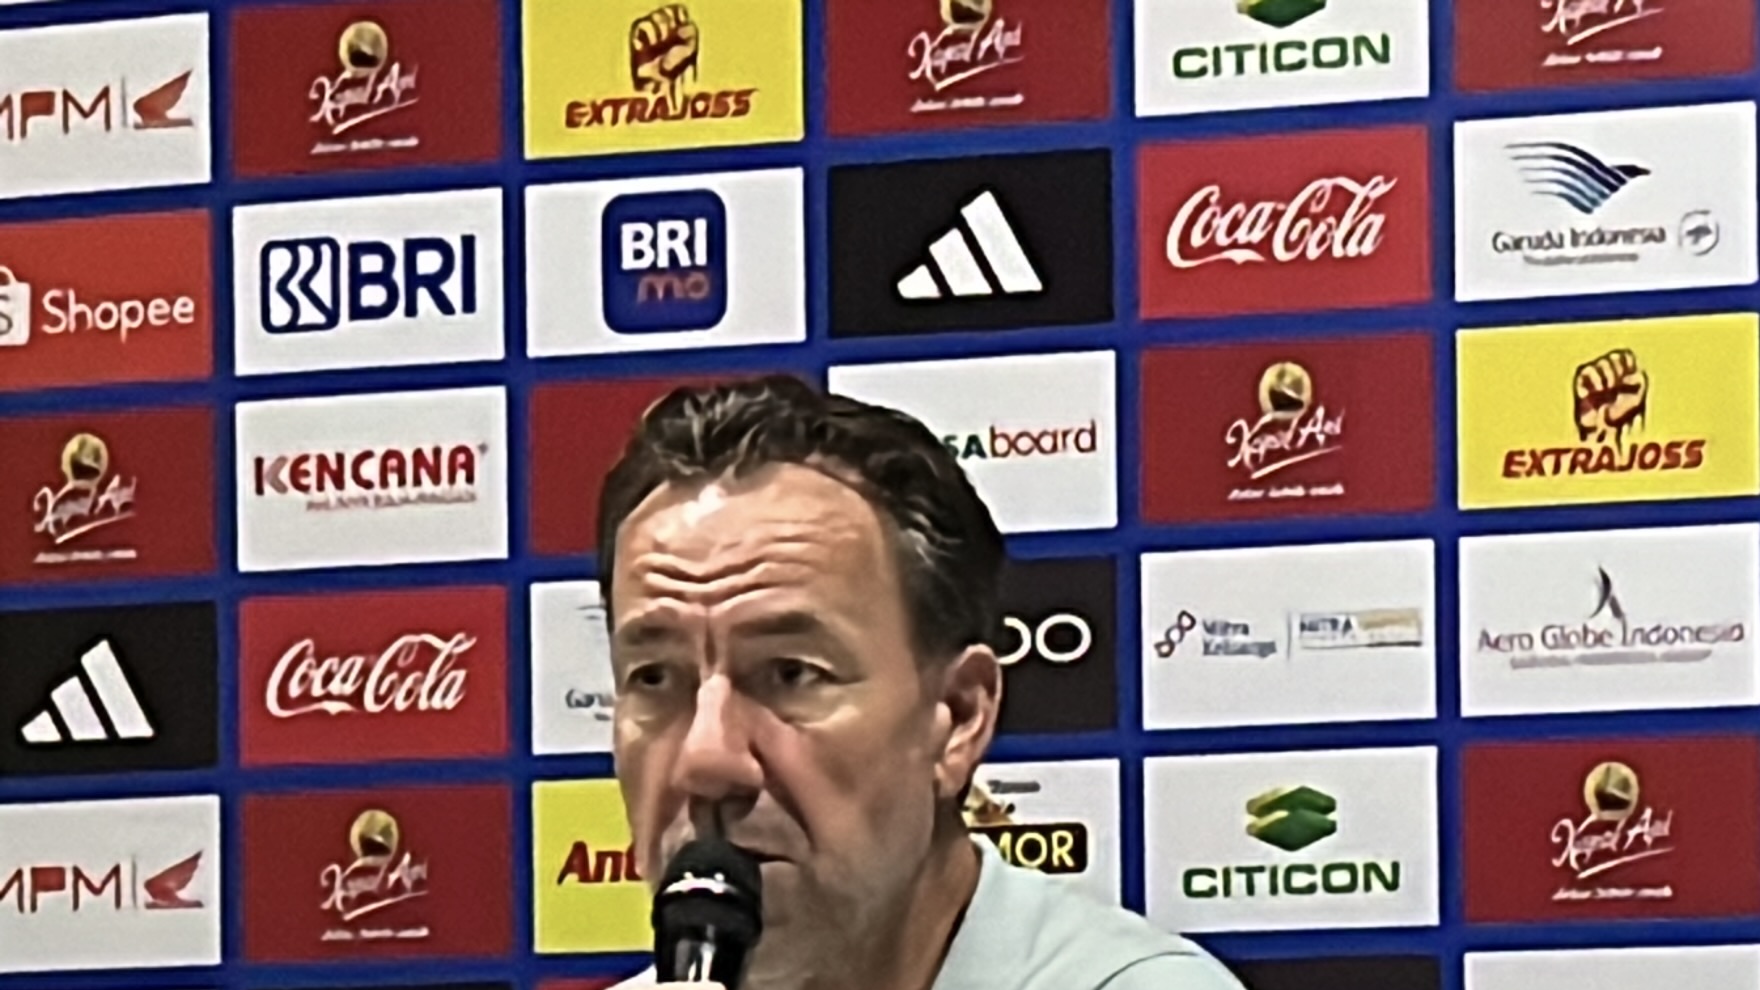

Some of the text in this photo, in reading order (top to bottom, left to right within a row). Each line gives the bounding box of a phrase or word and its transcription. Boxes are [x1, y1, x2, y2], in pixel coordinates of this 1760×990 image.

[1172, 32, 1391, 79] CITICON
[620, 218, 708, 271] BRI
[347, 233, 477, 322] BRI
[42, 288, 195, 344] Shopee
[255, 443, 477, 495] KENCANA
[1181, 860, 1402, 899] CITICON
